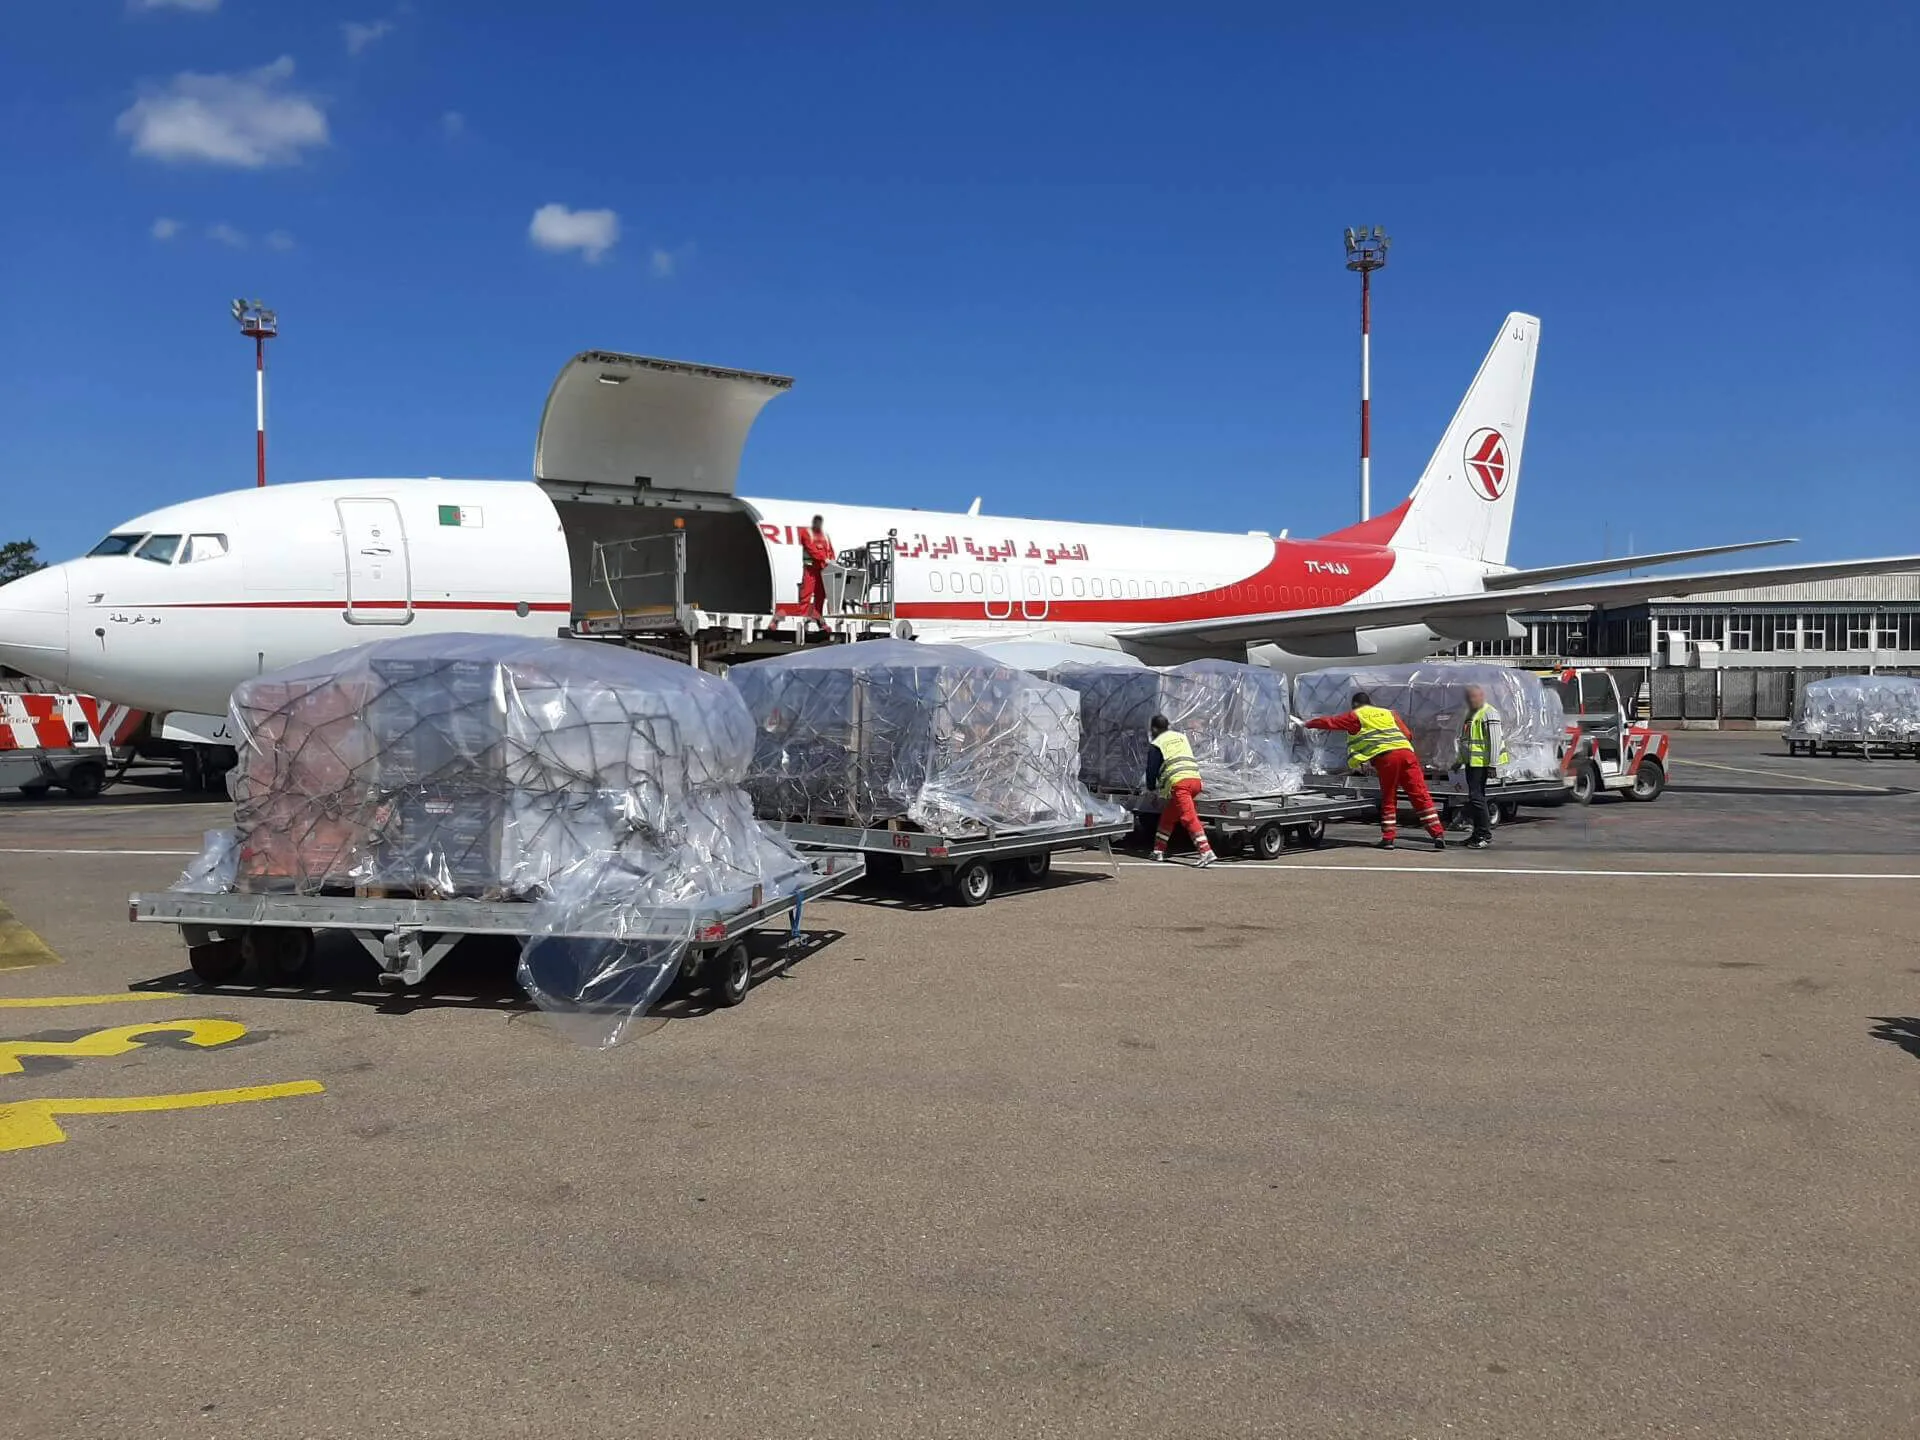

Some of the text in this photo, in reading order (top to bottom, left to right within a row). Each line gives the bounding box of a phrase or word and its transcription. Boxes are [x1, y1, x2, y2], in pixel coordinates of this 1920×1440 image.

[895, 534, 1089, 565] الخطوط الجوية الجزائري
